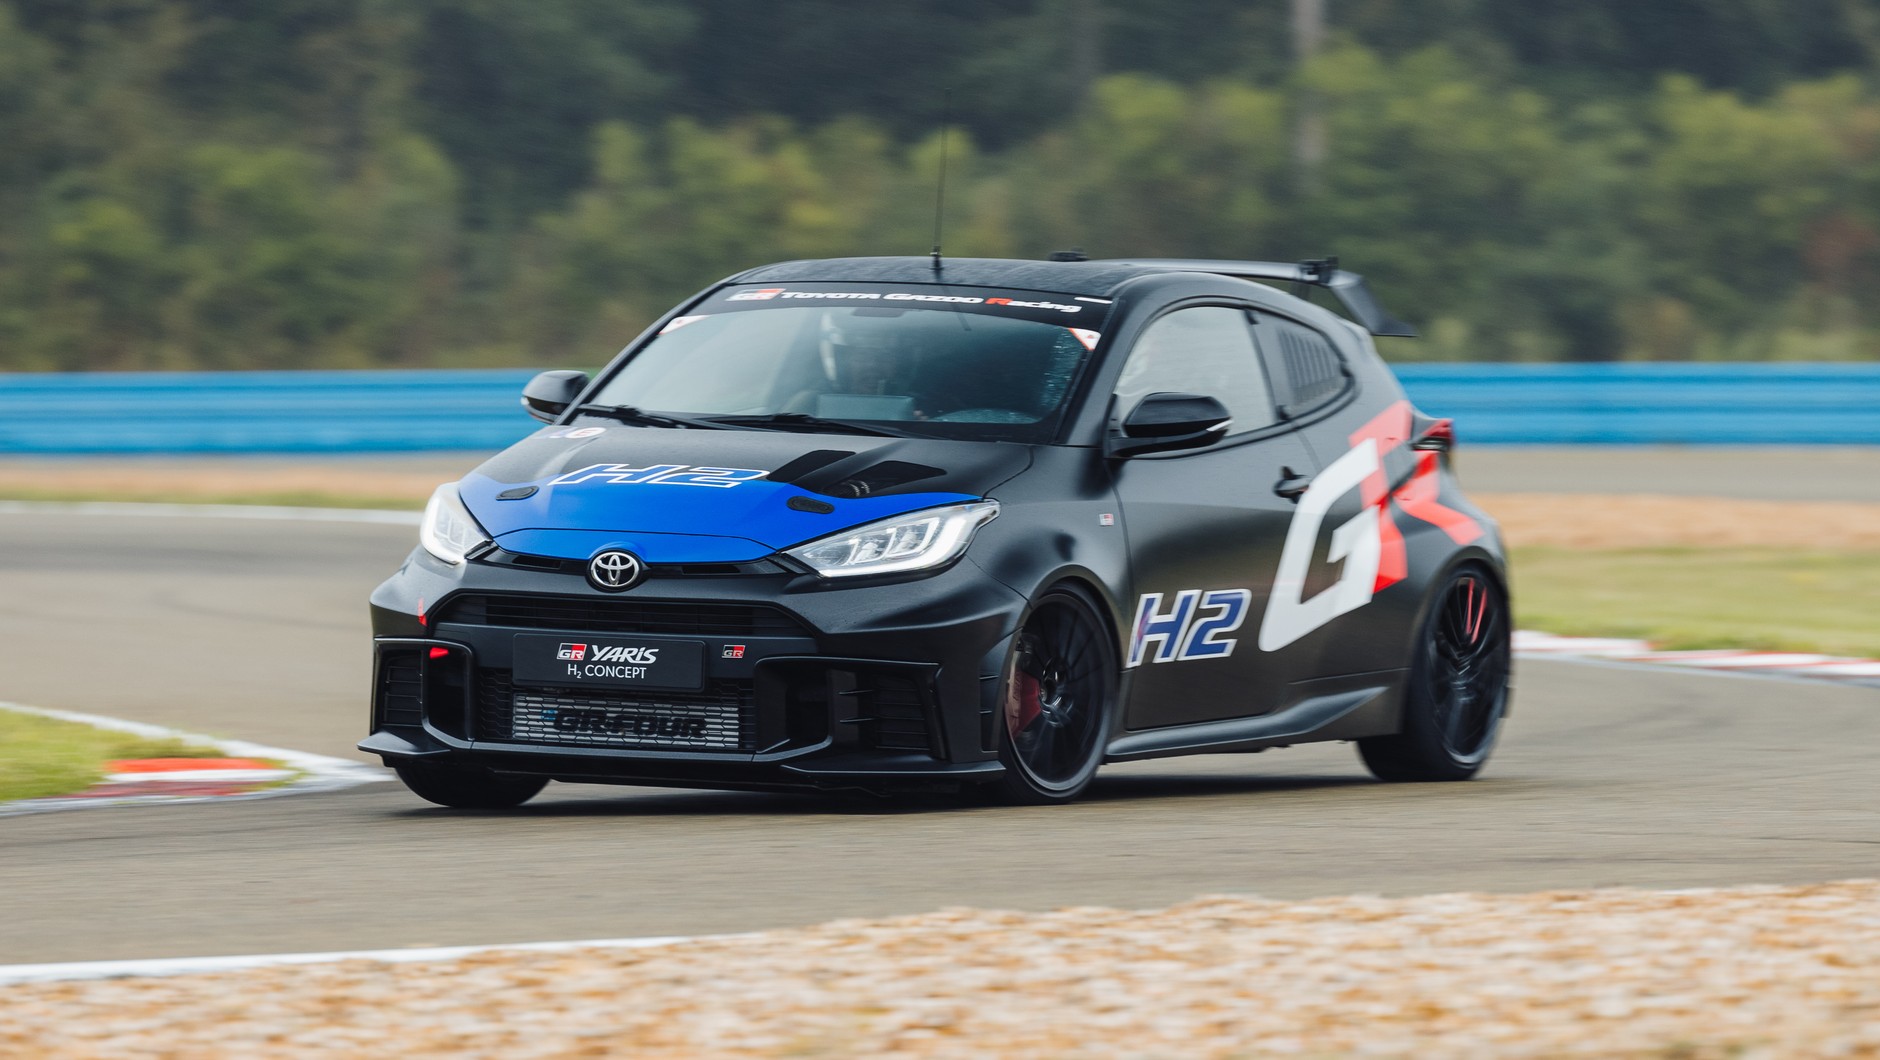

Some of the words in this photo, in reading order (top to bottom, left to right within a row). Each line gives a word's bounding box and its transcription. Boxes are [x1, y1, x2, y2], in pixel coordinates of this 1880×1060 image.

[781, 291, 882, 300] TOYOTA
[883, 293, 985, 304] GAZOO
[985, 297, 1083, 313] Racing
[547, 463, 771, 489] H2
[1258, 399, 1485, 653] GR
[1125, 588, 1253, 669] H2
[584, 664, 648, 679] CONCEPT
